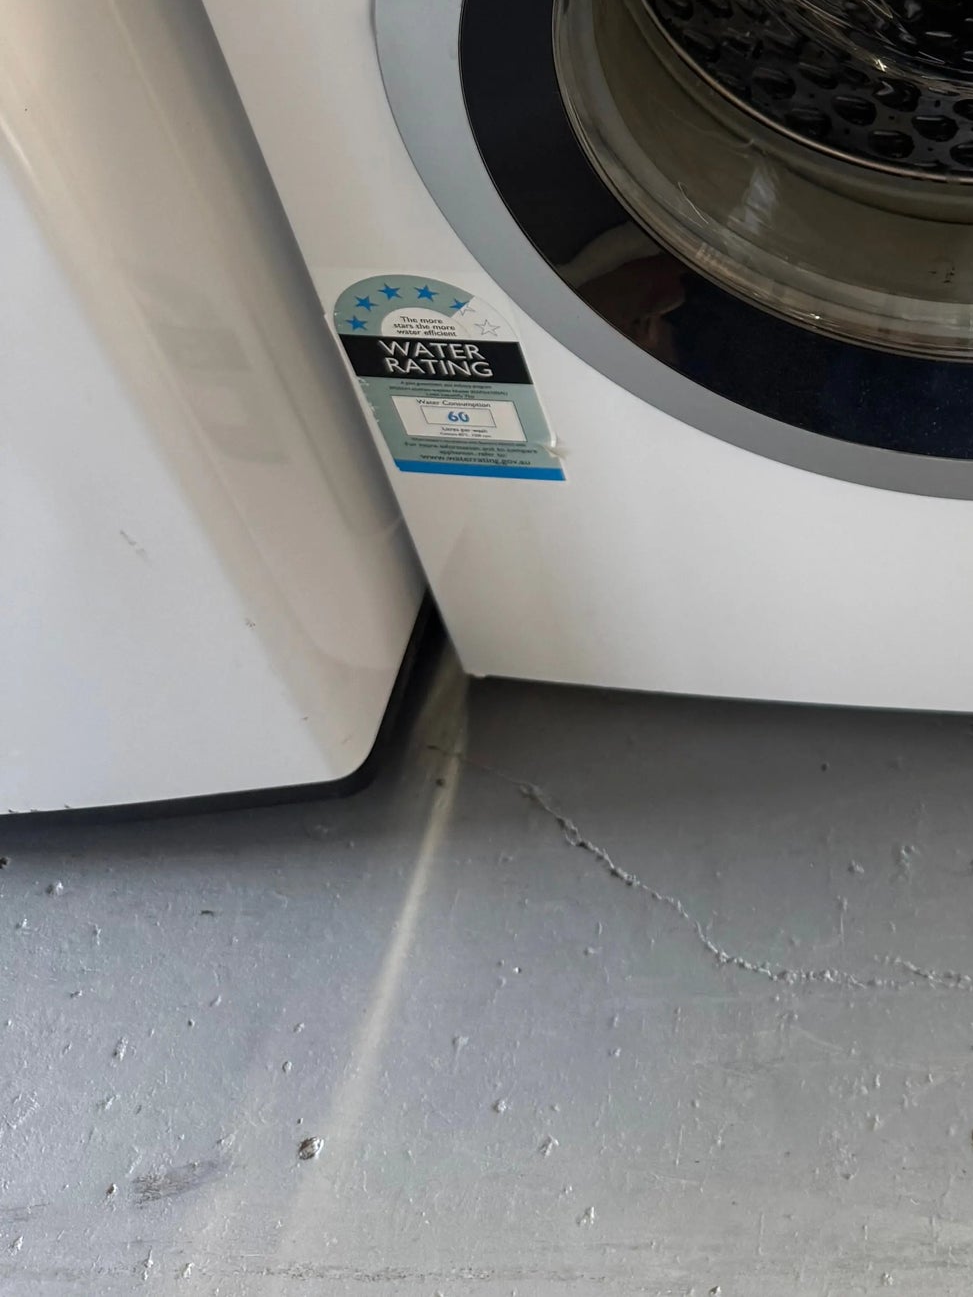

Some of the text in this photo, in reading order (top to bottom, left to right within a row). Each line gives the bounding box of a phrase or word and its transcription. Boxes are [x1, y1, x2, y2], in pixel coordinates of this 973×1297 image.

[379, 341, 485, 360] WATER
[385, 357, 493, 377] RATING
[442, 400, 491, 408] Consumption
[447, 411, 470, 422] 60
